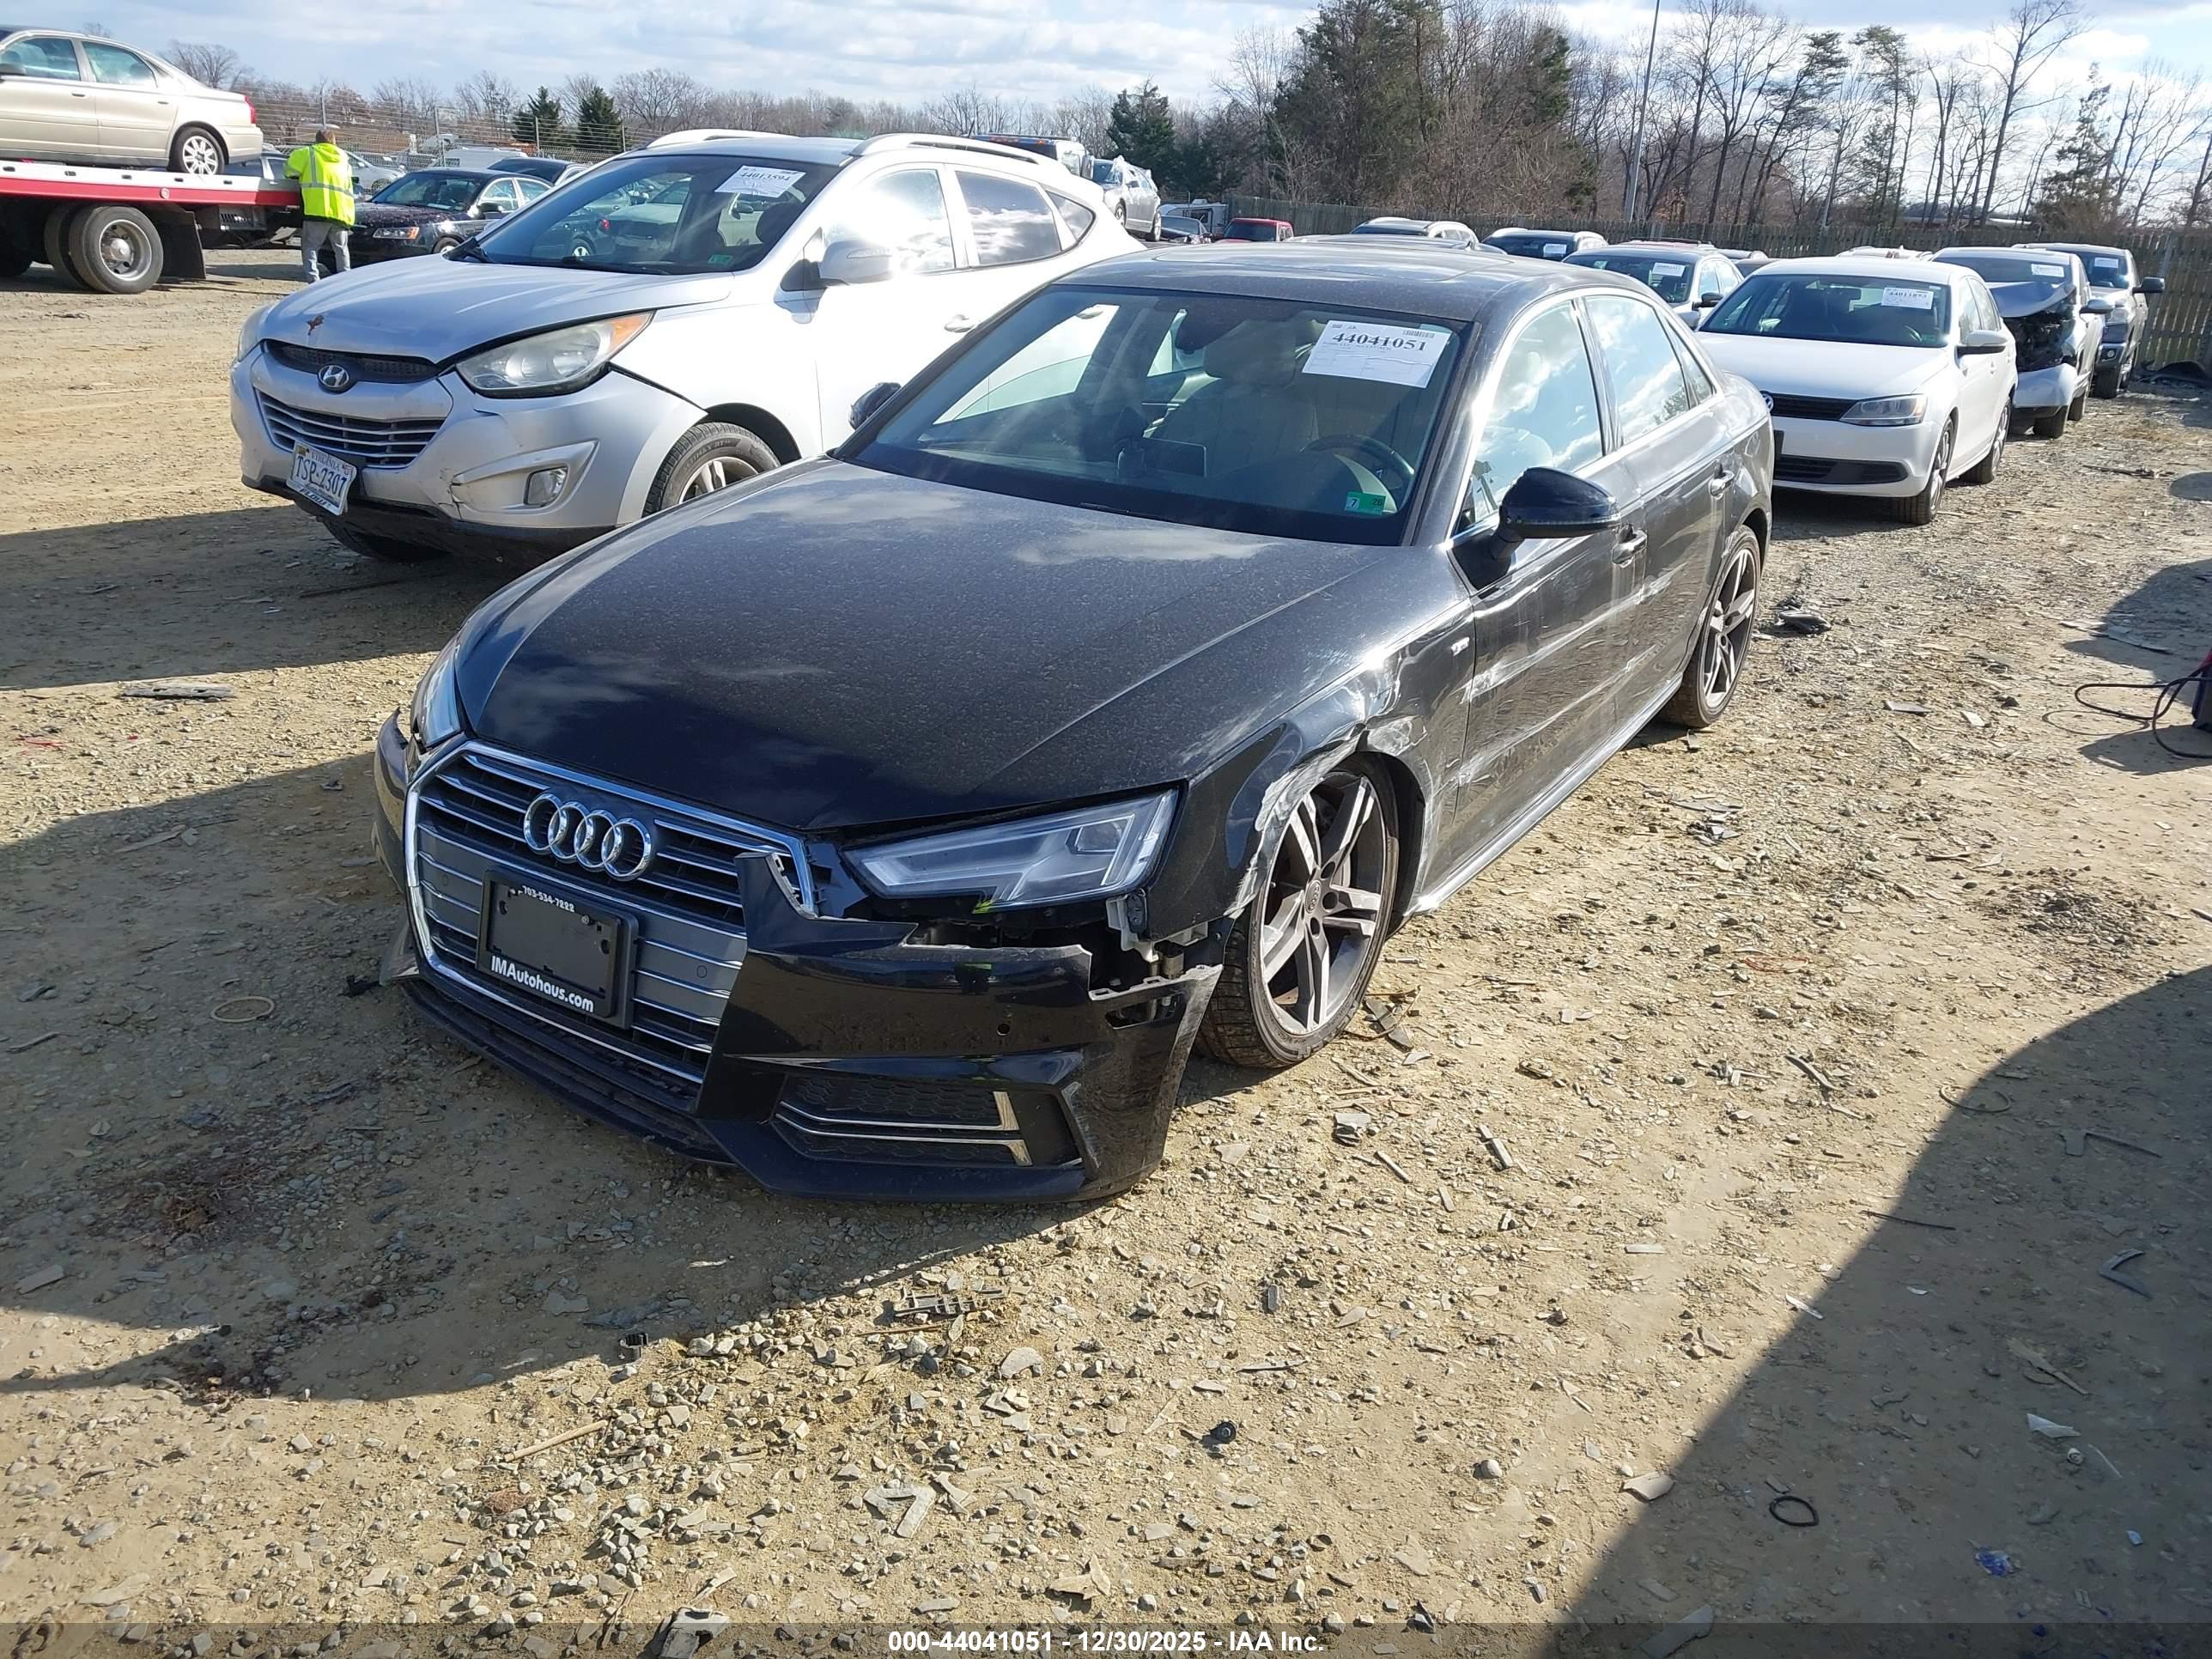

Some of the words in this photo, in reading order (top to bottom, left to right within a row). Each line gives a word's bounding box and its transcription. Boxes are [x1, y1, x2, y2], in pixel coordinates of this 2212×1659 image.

[1332, 332, 1428, 351] 44041051
[1351, 498, 1358, 507] 7
[521, 884, 575, 913] 703-534-7222
[490, 955, 595, 1013] IMAutohaus.com
